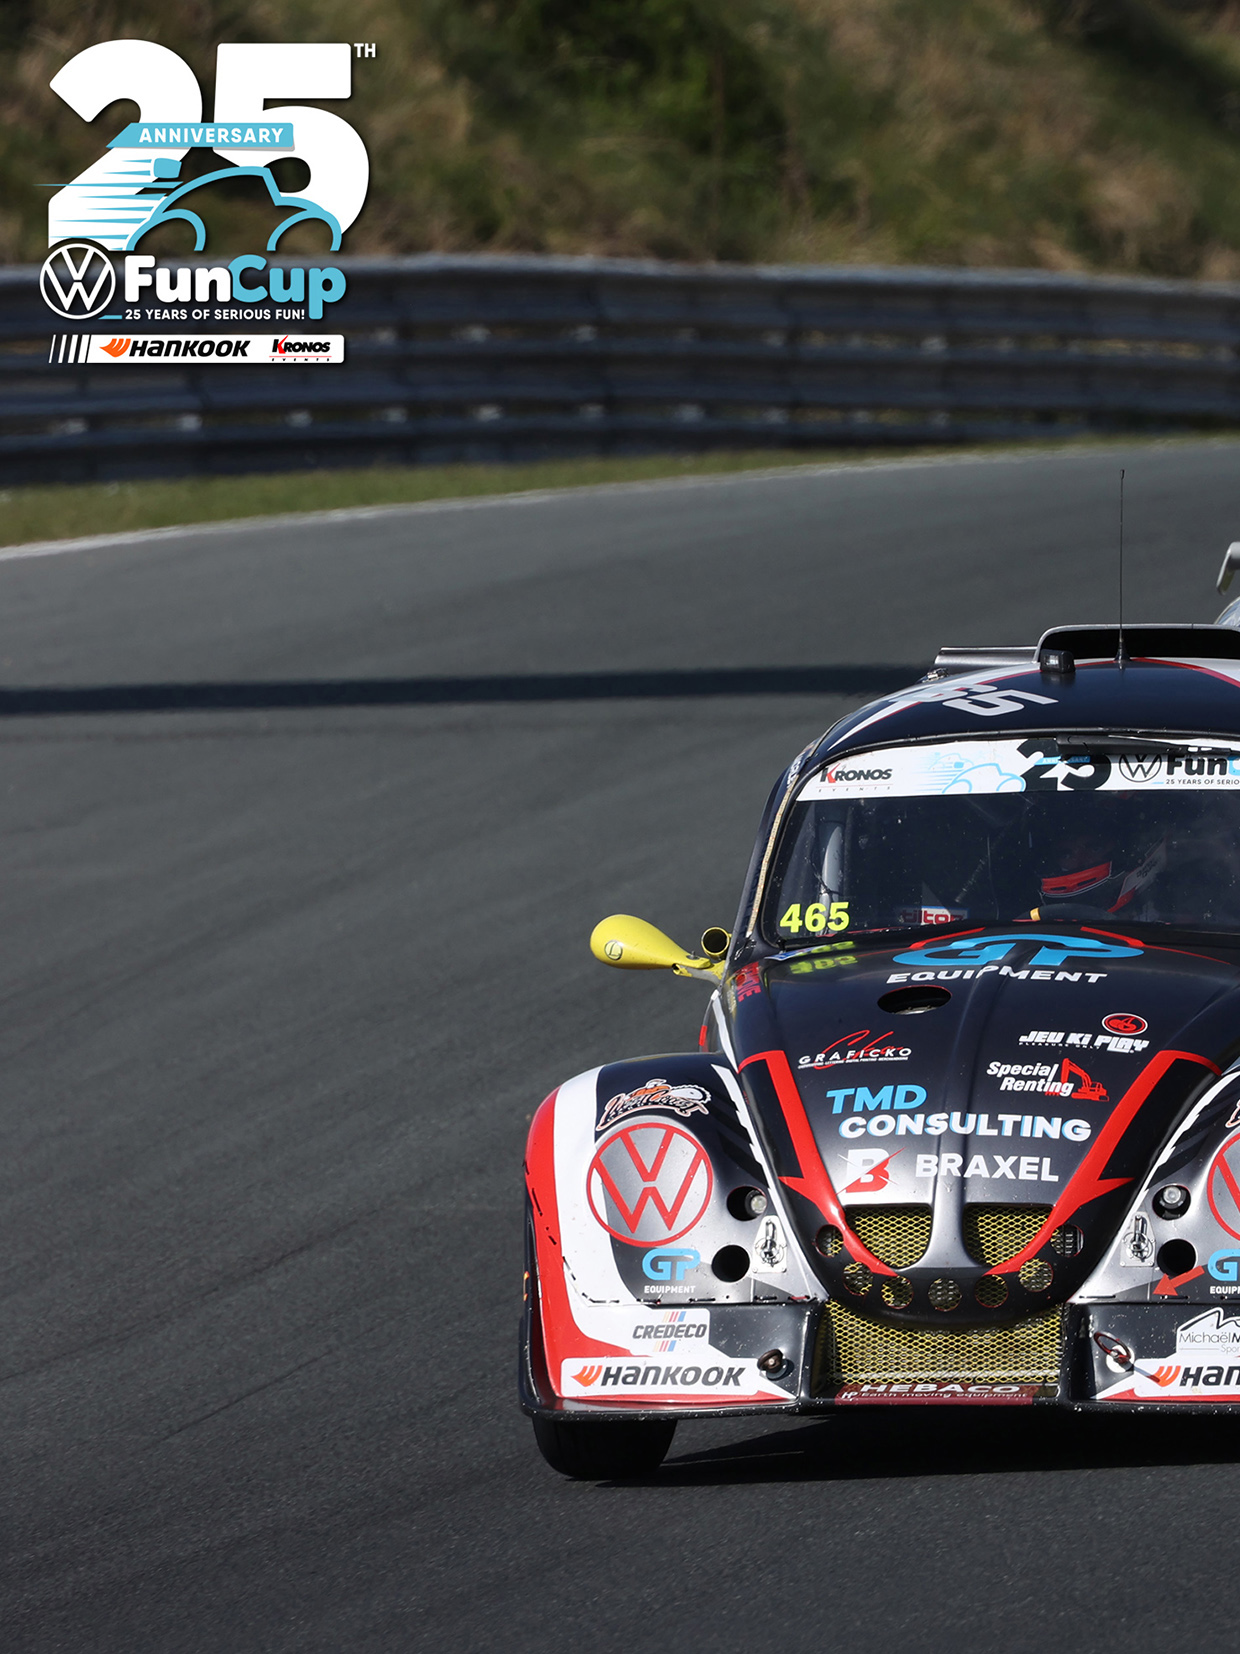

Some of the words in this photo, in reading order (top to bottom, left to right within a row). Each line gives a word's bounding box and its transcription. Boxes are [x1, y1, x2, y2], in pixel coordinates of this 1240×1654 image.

[820, 763, 893, 784] KRONOS
[779, 902, 850, 933] 465
[886, 966, 1107, 983] EQUIPMENT
[1019, 1031, 1065, 1043] JEU
[798, 1048, 911, 1065] GRAFICKO
[986, 1061, 1059, 1082] Special
[1000, 1077, 1074, 1097] Renting
[826, 1084, 927, 1114] TMD
[838, 1111, 1092, 1142] CONSULTING
[915, 1153, 1059, 1182] BRAXEL
[642, 1248, 701, 1281] GP
[644, 1285, 696, 1294] EQUIPMENT
[632, 1324, 707, 1339] CREDECO
[860, 1383, 1020, 1394] HEBACO
